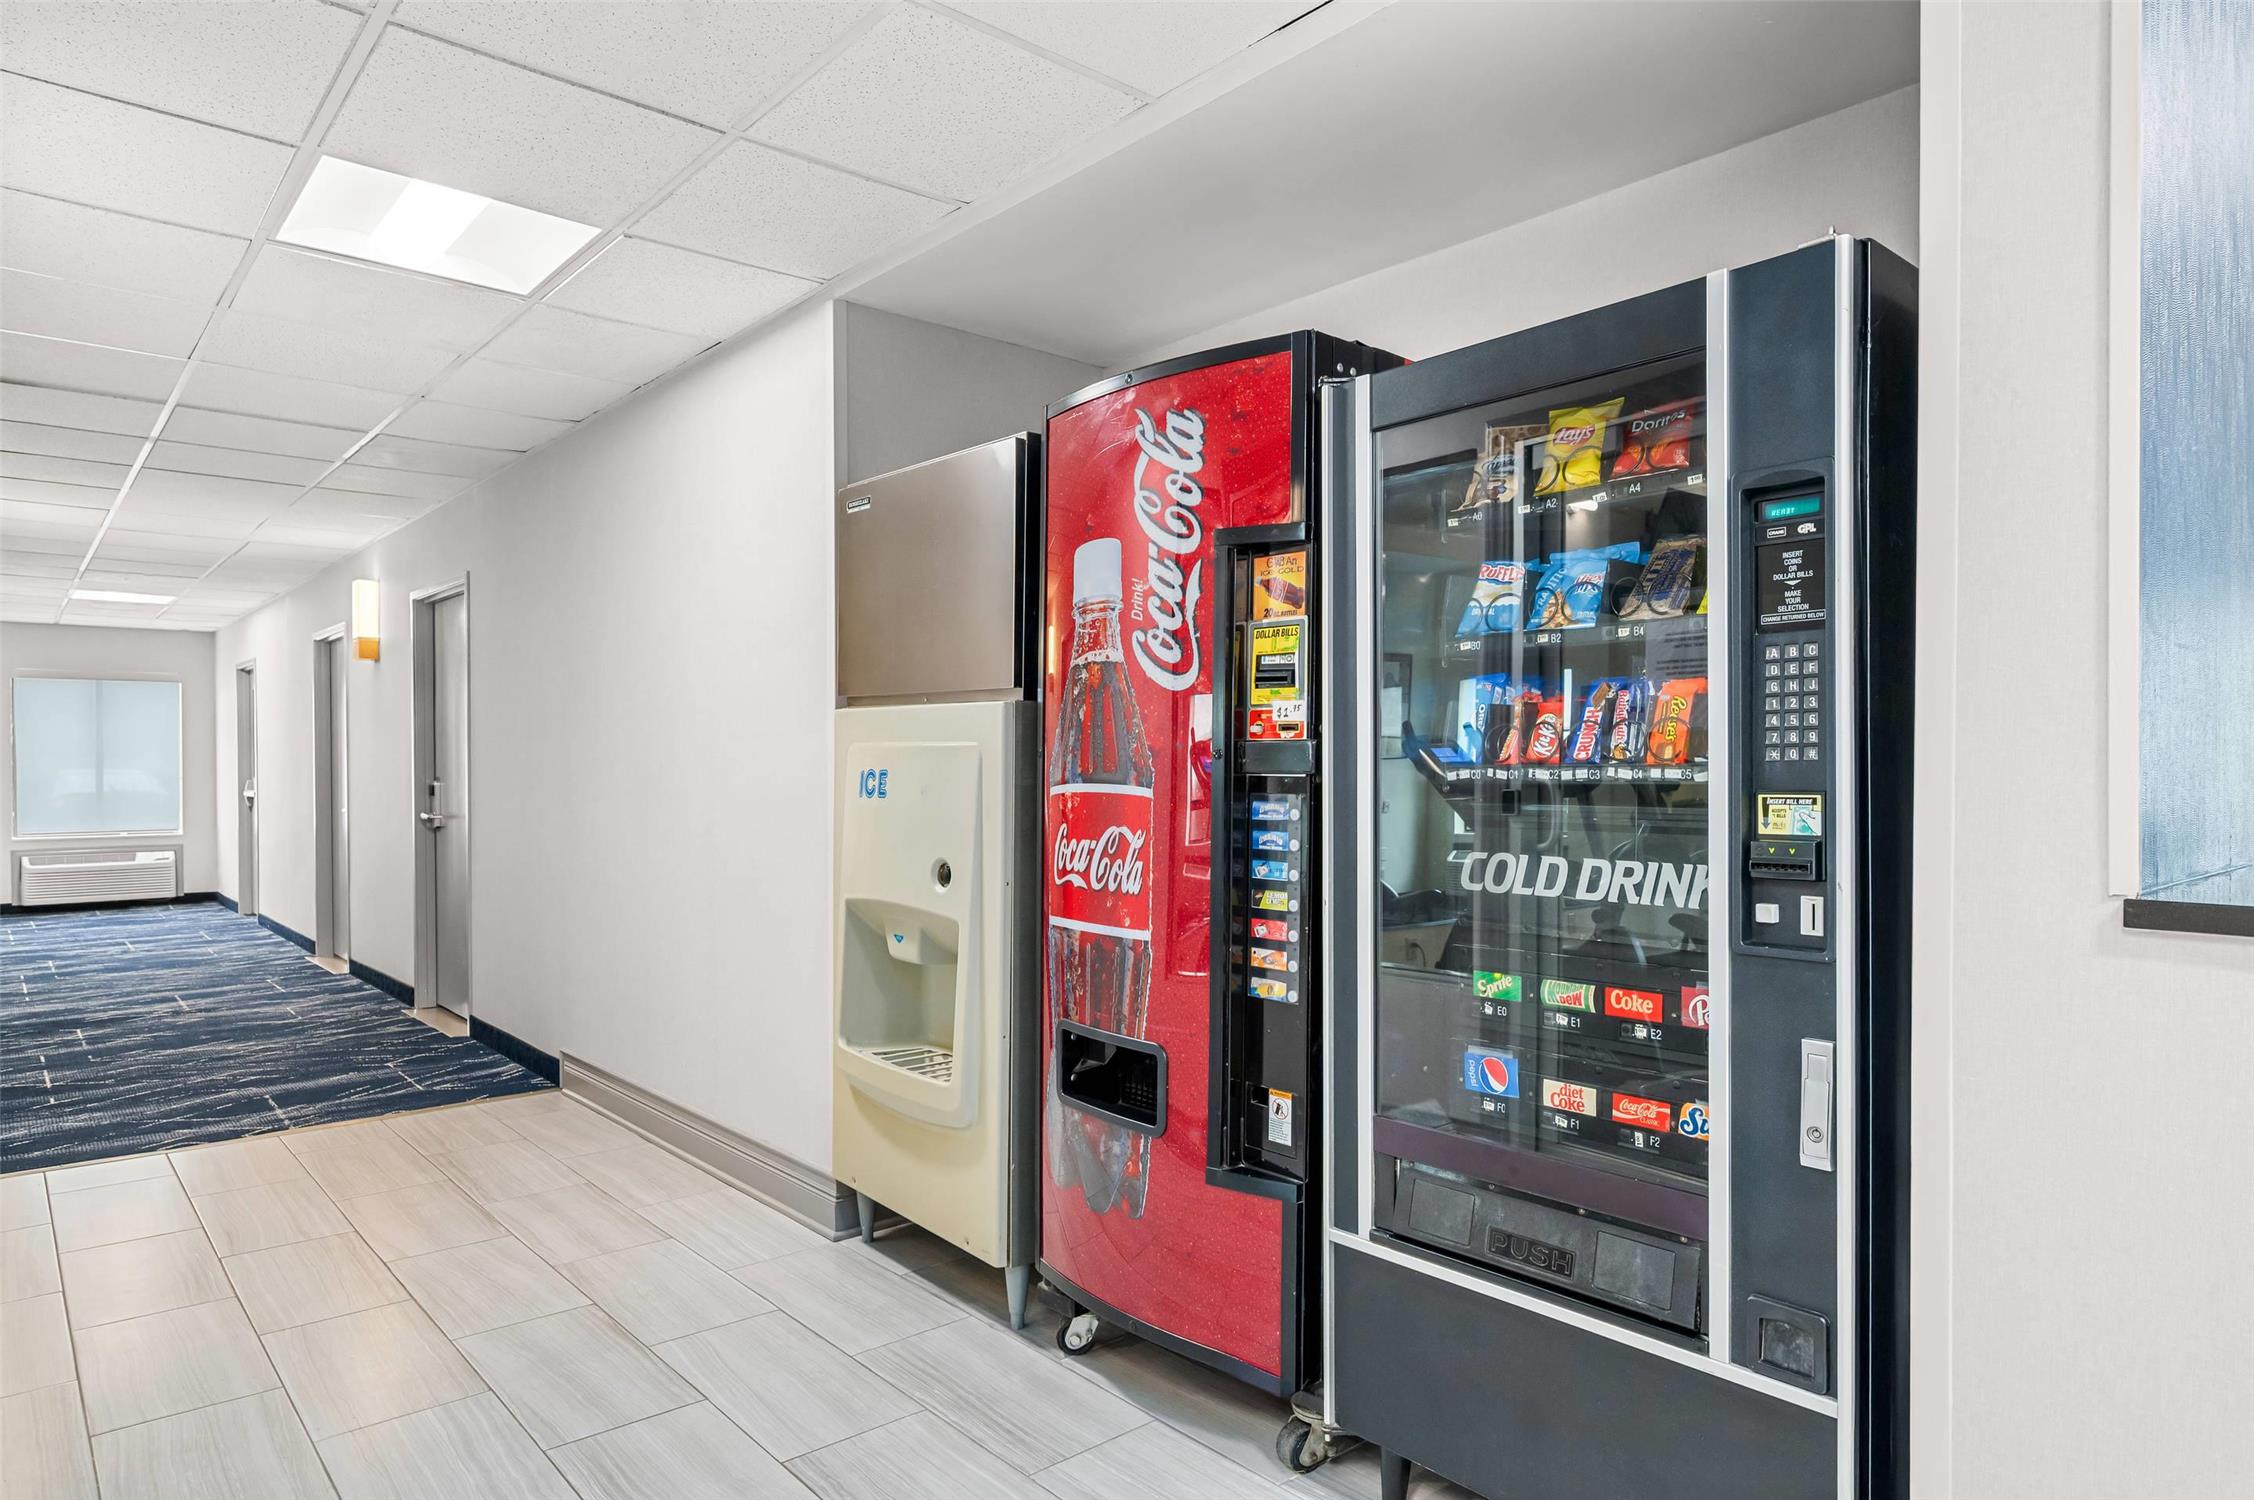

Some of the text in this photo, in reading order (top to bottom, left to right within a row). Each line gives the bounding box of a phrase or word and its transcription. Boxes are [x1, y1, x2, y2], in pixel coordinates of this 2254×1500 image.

[1631, 409, 1686, 432] Doritos
[1553, 423, 1595, 446] Lay's
[1629, 482, 1641, 494] A4
[1545, 498, 1557, 508] A2
[1472, 511, 1483, 520] A0
[1132, 408, 1205, 691] Coca-Cola
[1782, 550, 1804, 558] INSERT
[1773, 570, 1814, 580] DOLLAR BILLS
[1784, 589, 1802, 597] MAKE
[1777, 604, 1809, 612] SELECTION
[1256, 627, 1299, 639] DOLLAR BILLS
[1633, 626, 1644, 636] B4
[1550, 633, 1562, 643] B2
[1770, 645, 1816, 658] A B C
[1771, 662, 1816, 675] D E F
[1770, 679, 1816, 692] G H J
[1772, 697, 1816, 709] 1 2 3
[1770, 714, 1816, 725] 4 5 6
[1771, 731, 1816, 742] 7 8 9
[1790, 749, 1796, 759] 0
[1471, 769, 1481, 779] C0
[1508, 769, 1519, 779] C1
[1548, 770, 1559, 779] C2
[1588, 769, 1600, 779] C3
[1633, 768, 1642, 779] C4
[1680, 769, 1692, 779] C5
[859, 768, 888, 798] ICE
[1054, 823, 1146, 895] Coca-Cola
[1460, 852, 1568, 898] COLD
[1478, 975, 1512, 998] Sprite
[1611, 989, 1653, 1014] Coke
[1497, 1006, 1507, 1016] E0
[1570, 1016, 1580, 1028] E1
[1650, 1029, 1662, 1040] E2
[1469, 1059, 1479, 1088] pepsi
[1560, 1083, 1584, 1100] diet
[1497, 1102, 1506, 1113] F0
[1551, 1092, 1585, 1112] Coke
[1620, 1098, 1657, 1119] Coca-Cola
[1570, 1118, 1579, 1130] F1
[1650, 1135, 1661, 1148] F2
[1489, 1232, 1574, 1275] PUSH
